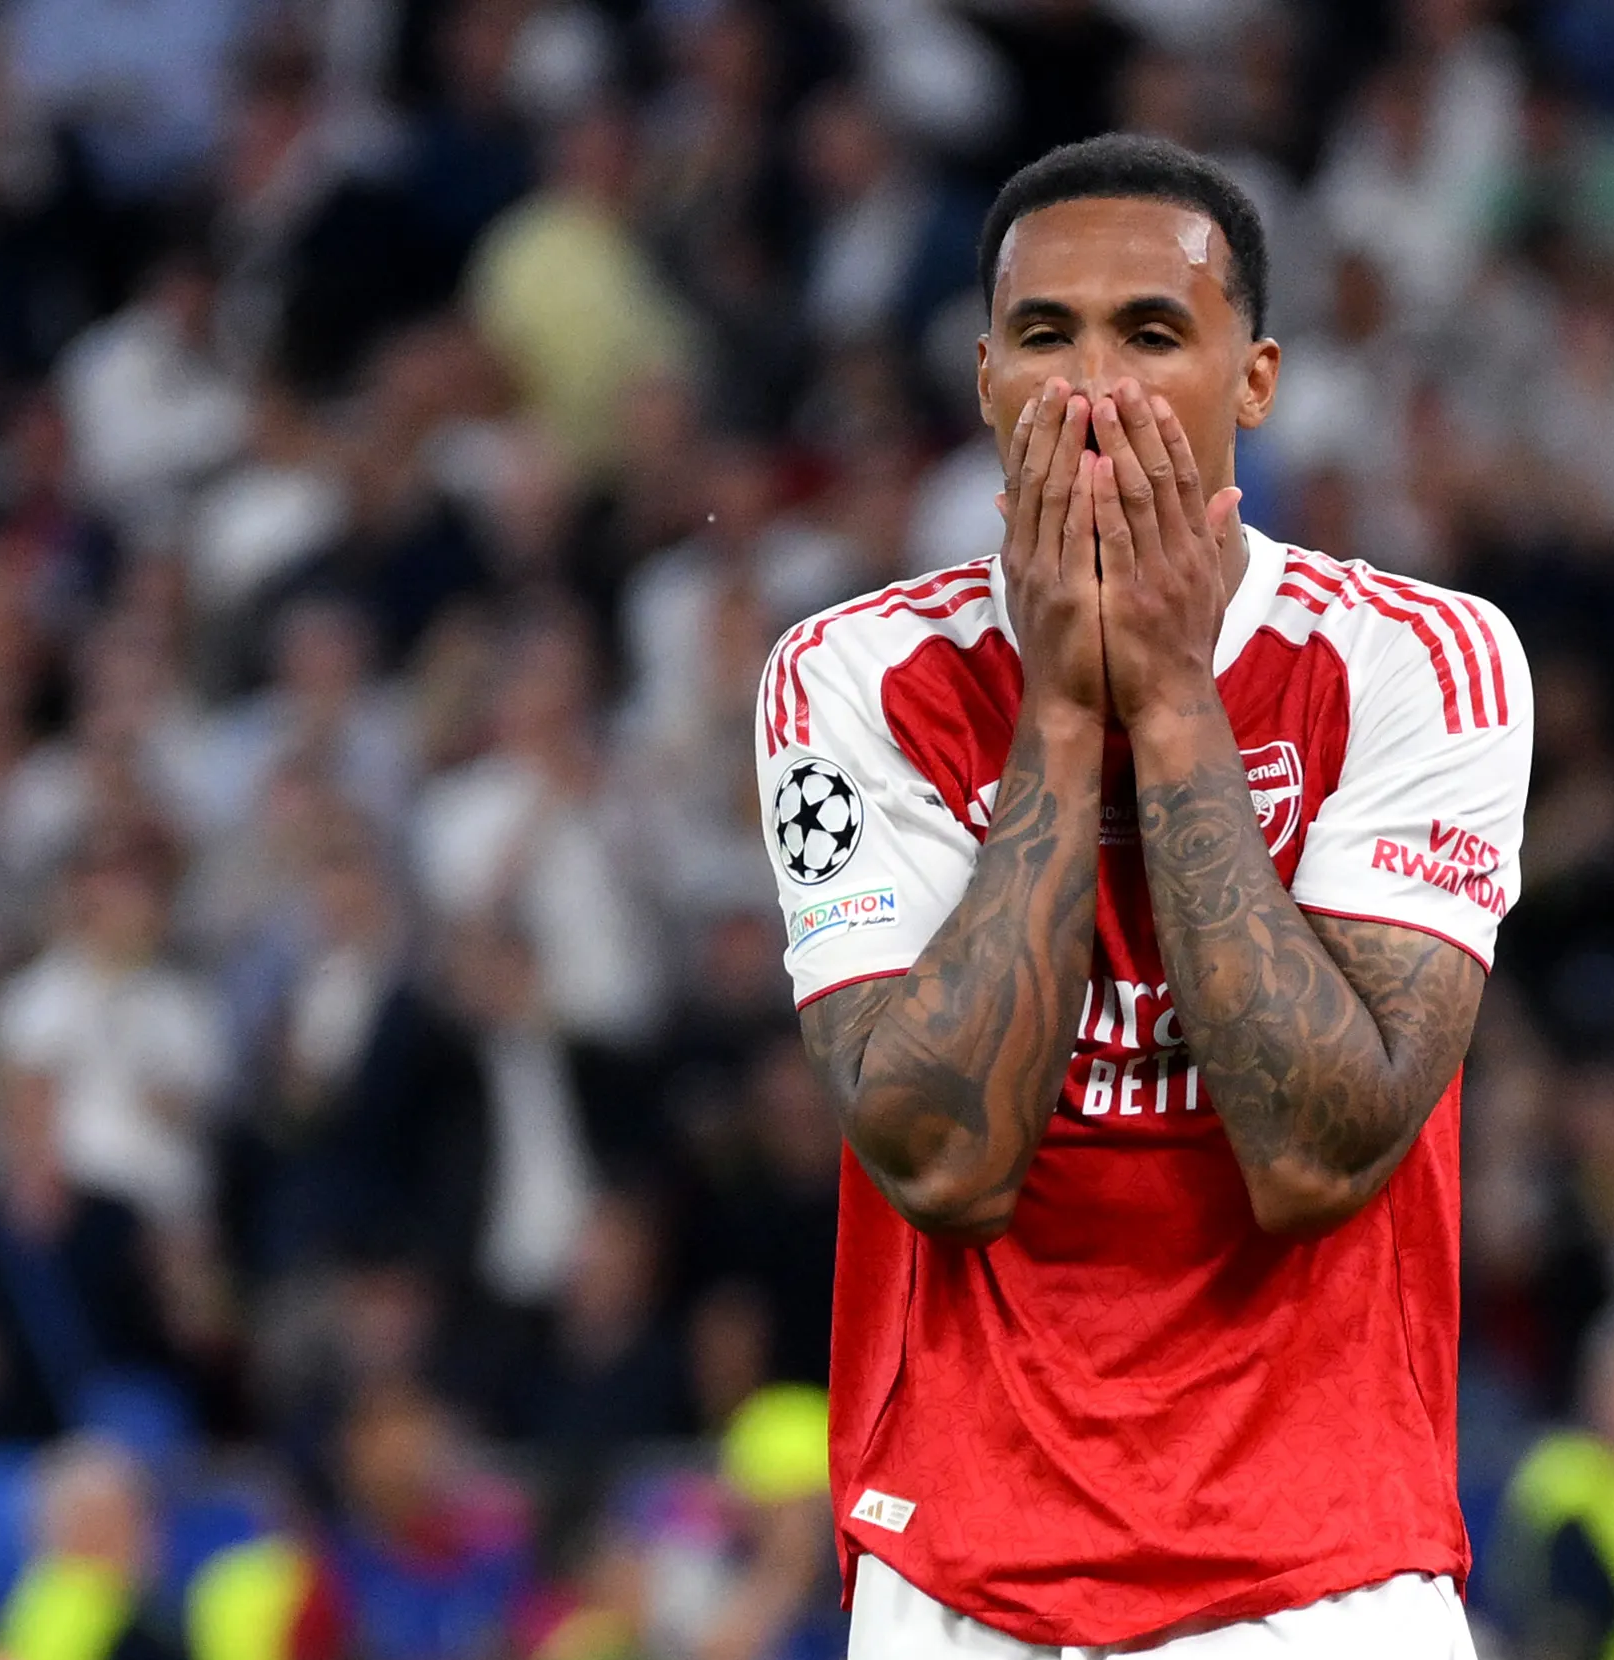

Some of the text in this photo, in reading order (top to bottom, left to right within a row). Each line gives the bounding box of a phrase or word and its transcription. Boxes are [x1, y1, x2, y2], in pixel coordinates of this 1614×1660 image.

[1245, 757, 1288, 782] enal
[1430, 819, 1500, 871] VISIT
[1371, 838, 1507, 919] RWANDA
